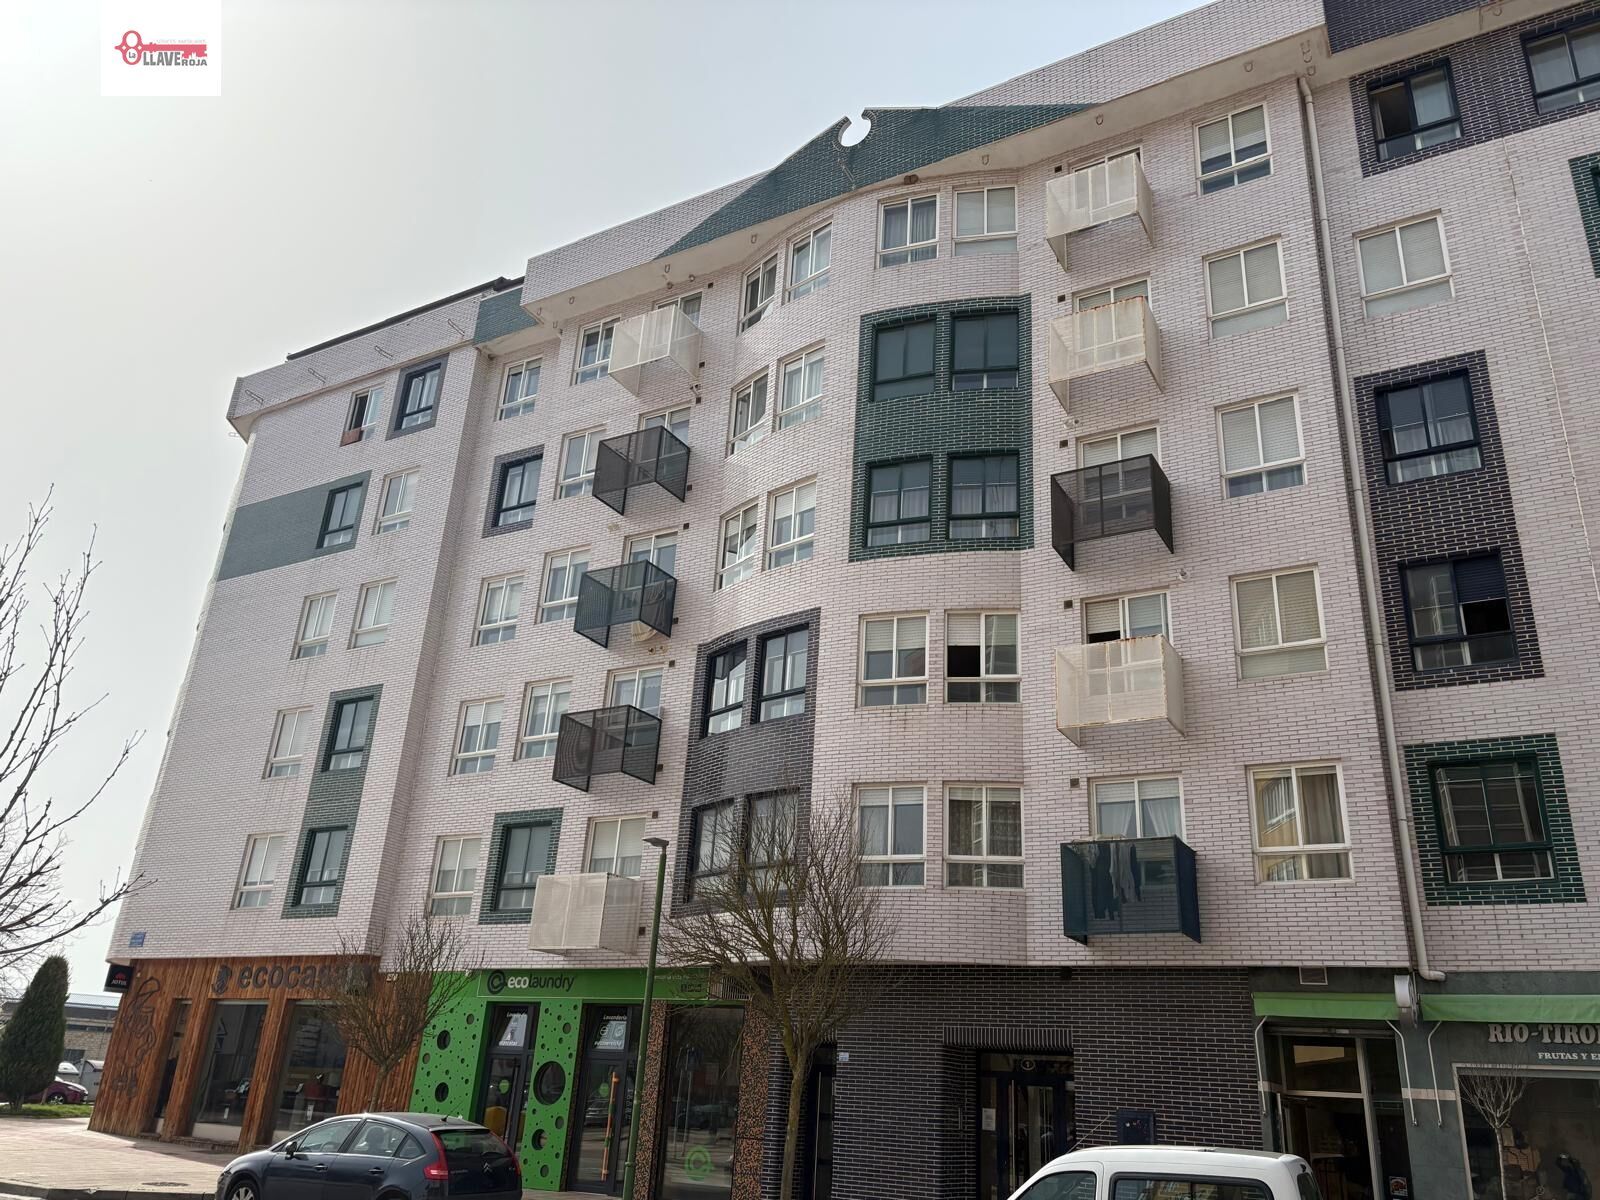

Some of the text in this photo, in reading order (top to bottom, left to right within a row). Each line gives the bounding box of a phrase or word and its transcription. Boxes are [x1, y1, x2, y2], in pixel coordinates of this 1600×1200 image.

[507, 974, 575, 992] ecolaundry
[1488, 1024, 1600, 1044] RIO-TIRO
[1537, 1052, 1579, 1060] FRUTAS
